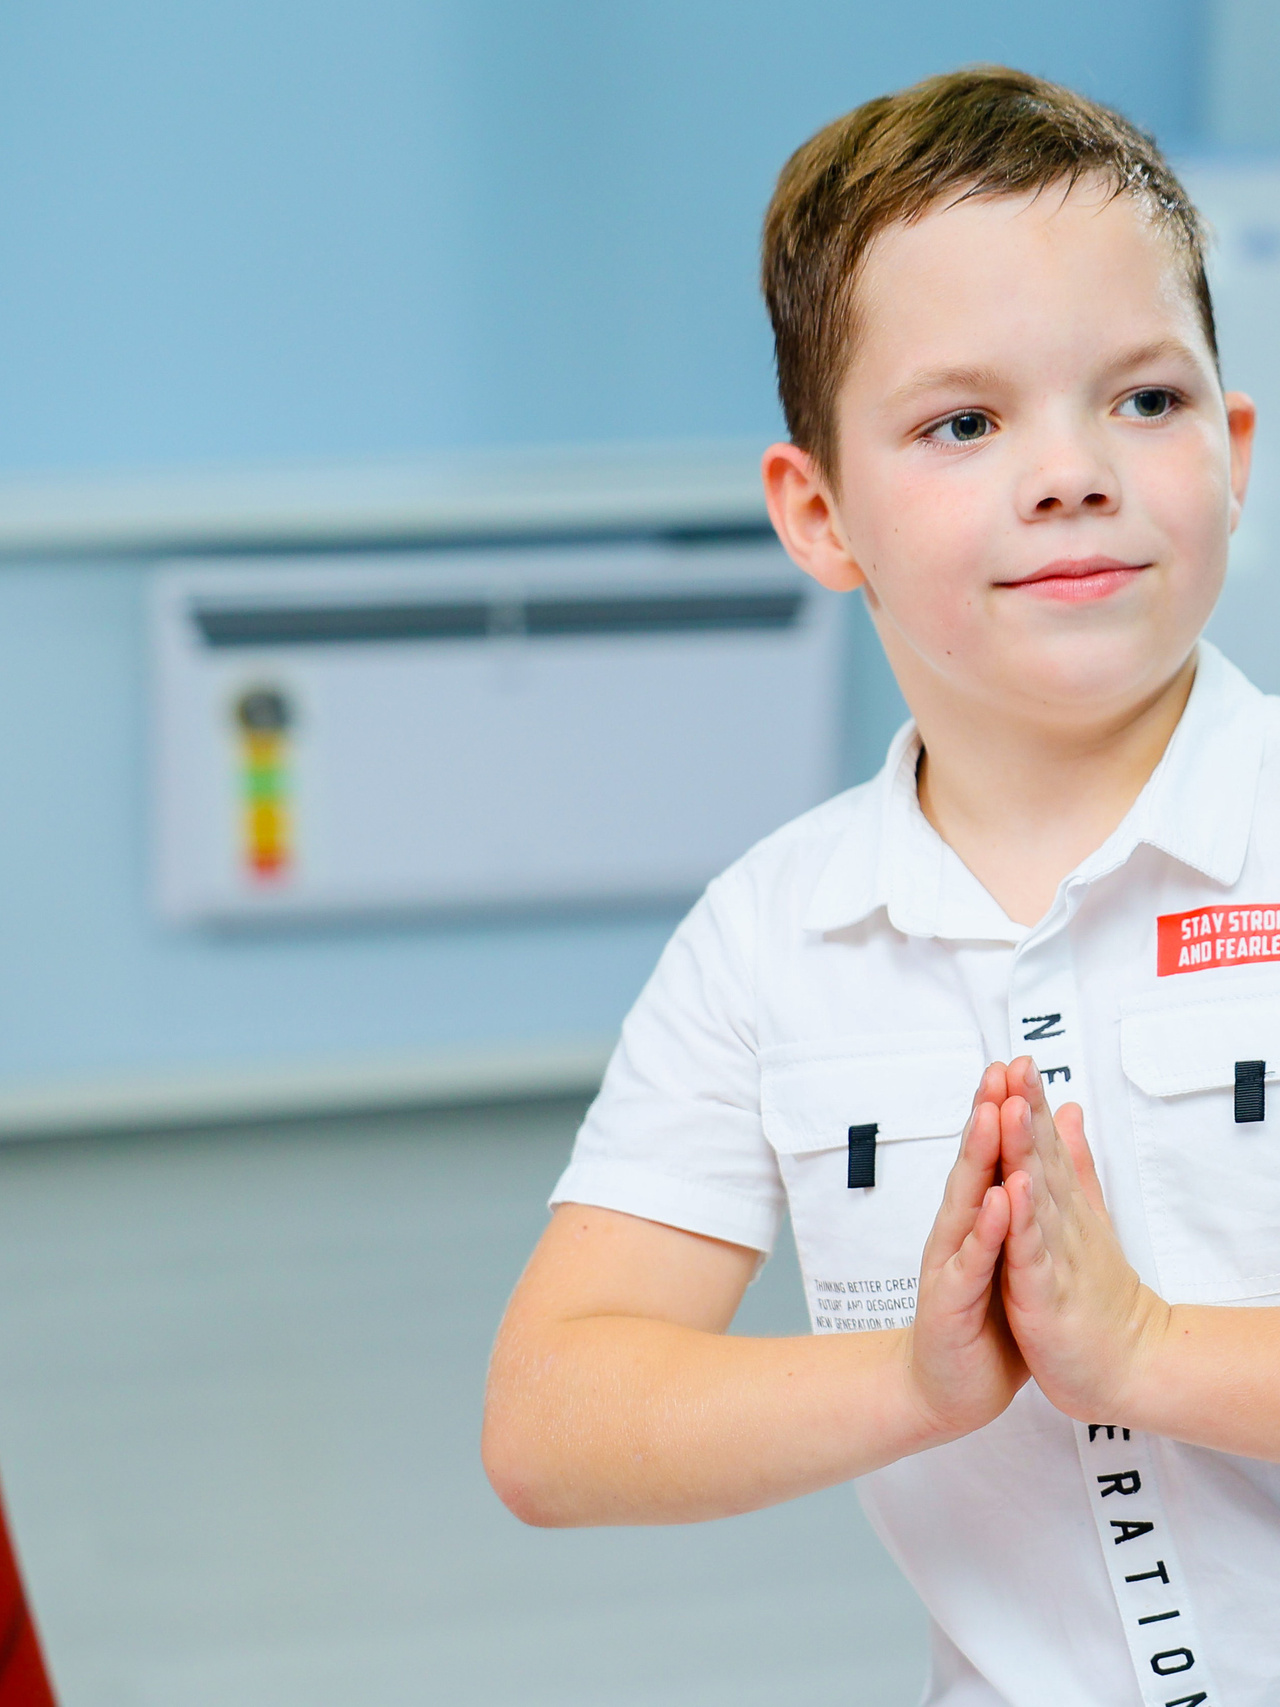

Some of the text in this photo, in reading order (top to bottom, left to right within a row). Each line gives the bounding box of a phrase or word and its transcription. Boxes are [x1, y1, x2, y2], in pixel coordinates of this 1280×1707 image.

[1181, 911, 1224, 940] STAY
[1178, 941, 1211, 967] AND
[847, 1279, 882, 1293] BETTER
[885, 1277, 917, 1292] CREAT
[866, 1296, 915, 1312] DESIGNED
[816, 1316, 833, 1329] NEW
